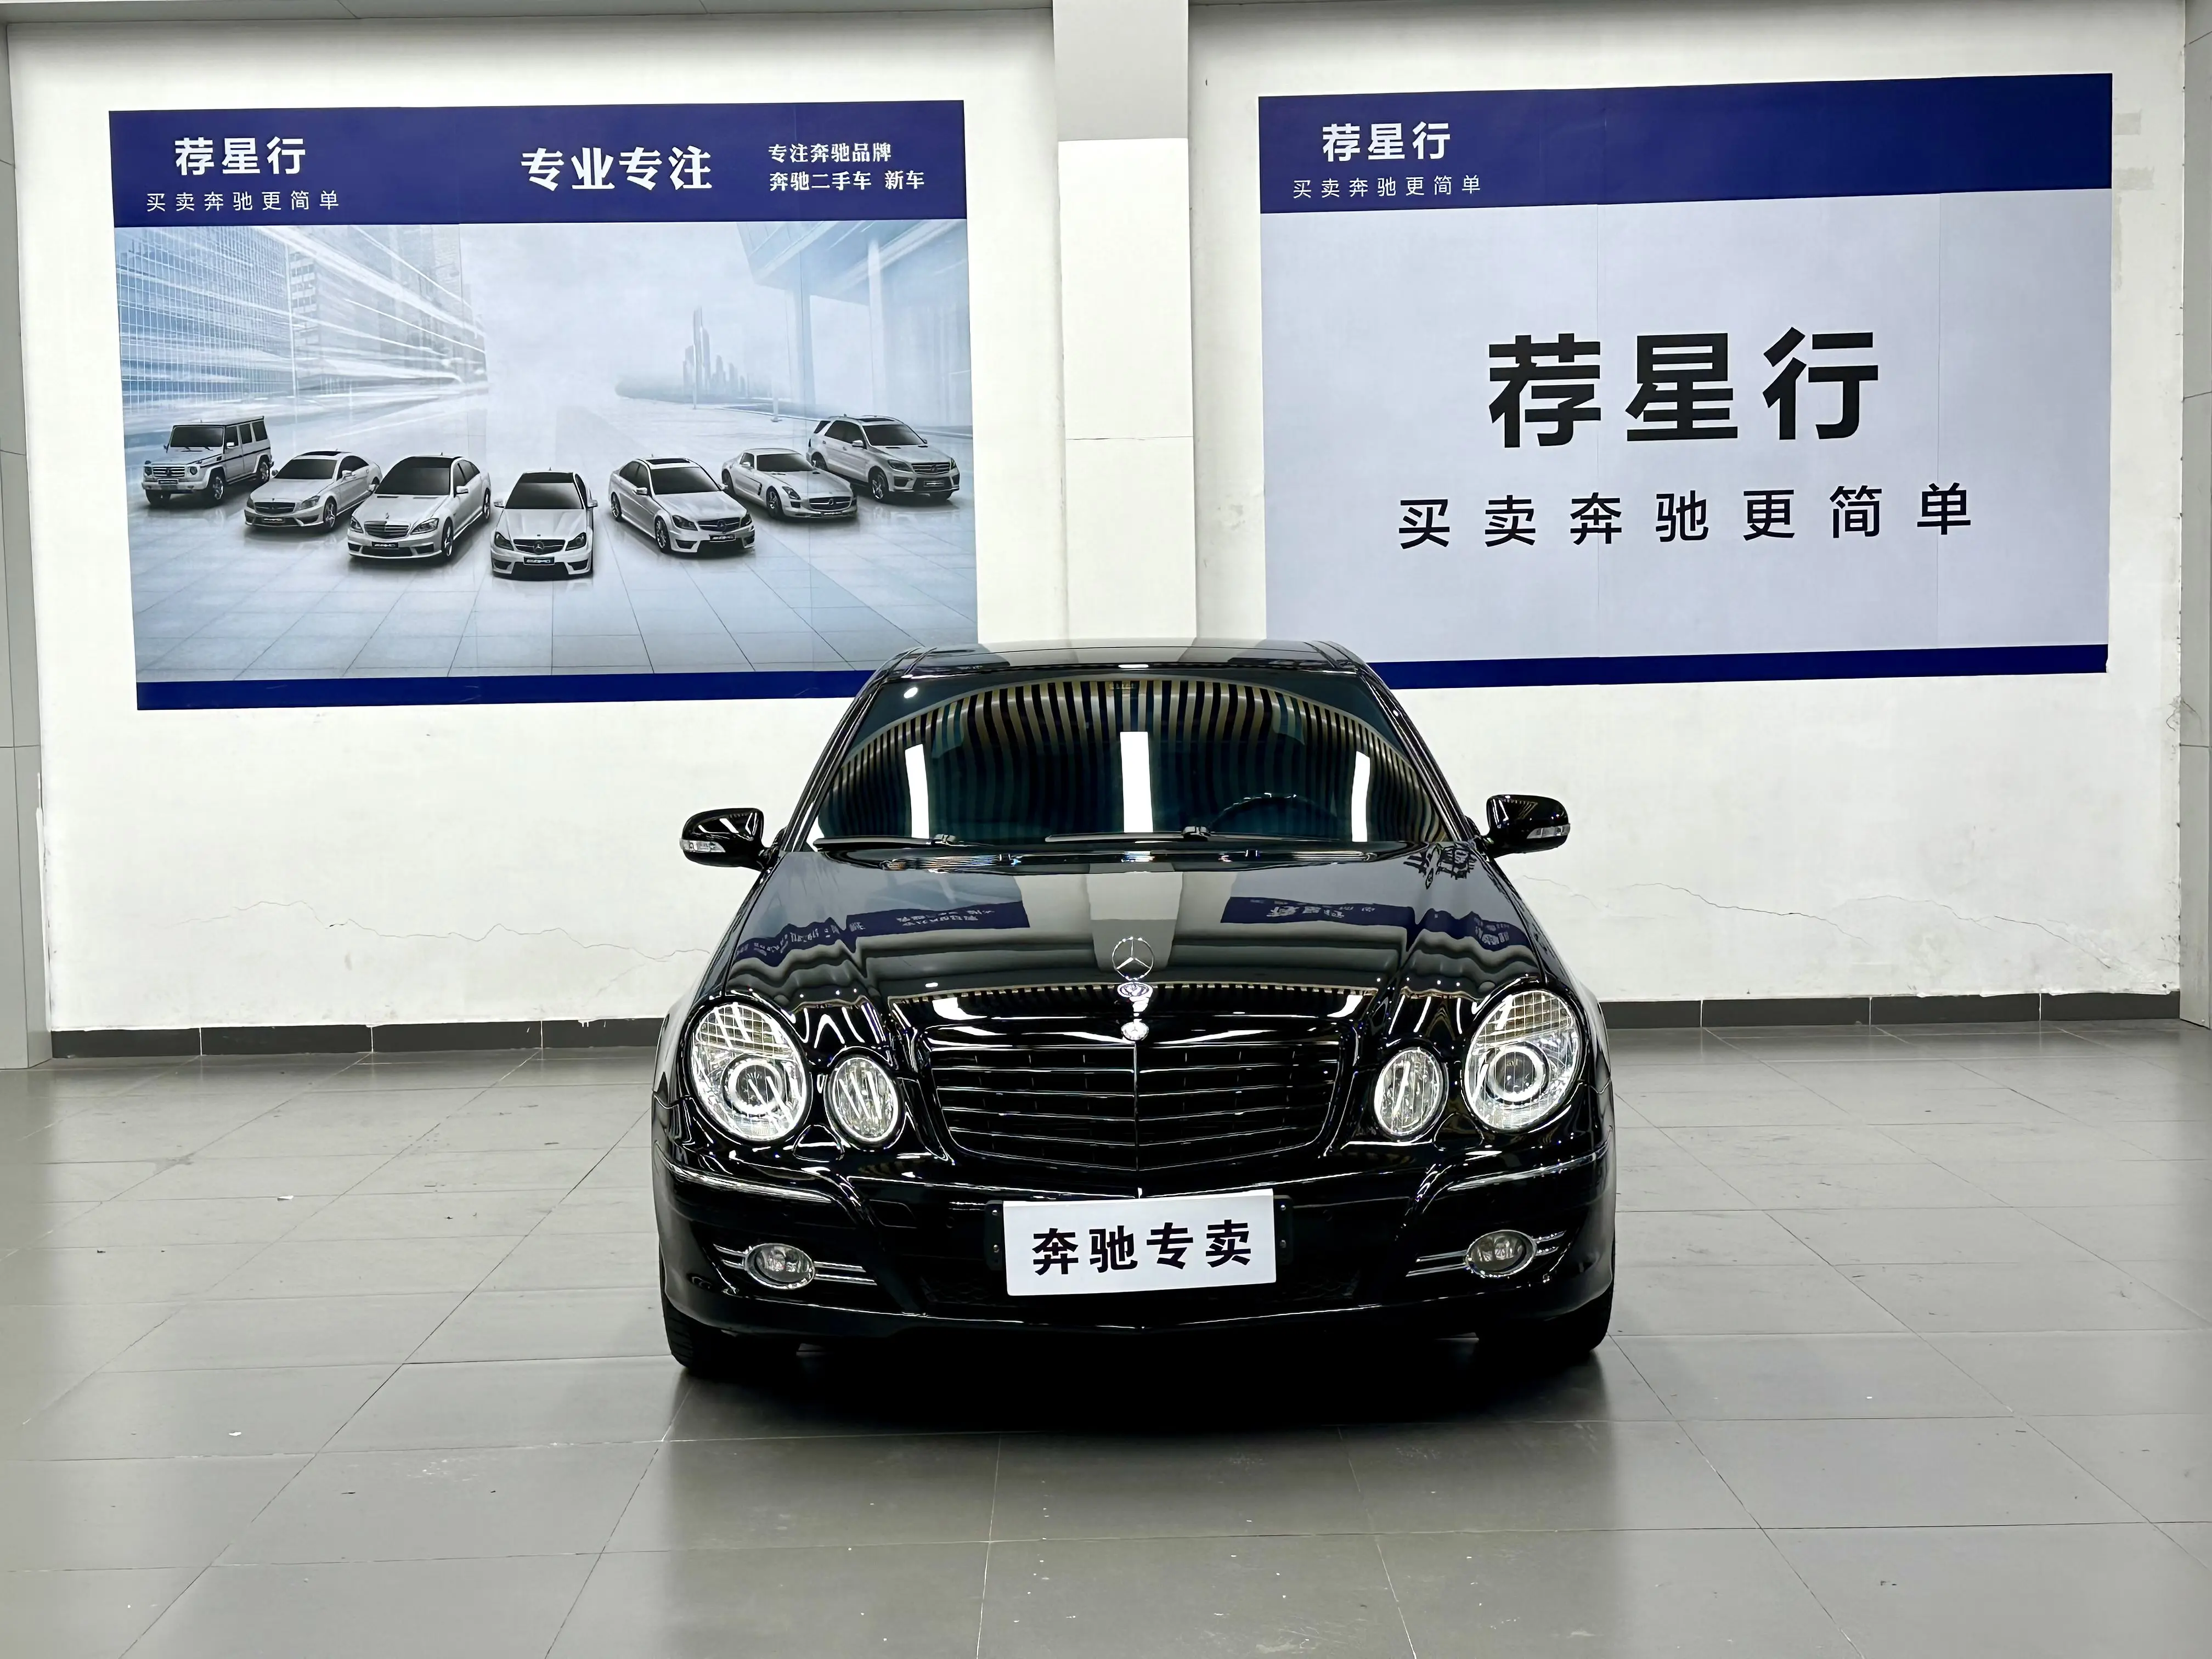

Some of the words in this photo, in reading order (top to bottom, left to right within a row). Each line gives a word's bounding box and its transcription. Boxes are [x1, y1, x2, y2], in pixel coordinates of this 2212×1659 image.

[174, 136, 306, 176] 荐星行
[768, 142, 891, 163] 专注奔驰品牌
[1323, 121, 1451, 162] 荐星行
[521, 145, 713, 191] 专业专注
[770, 171, 872, 191] 奔驰二手车
[884, 170, 924, 190] 新车
[1293, 174, 1481, 199] 买卖奔驰更简单
[146, 190, 339, 212] 买卖奔驰更简单
[1488, 326, 1878, 448] 荐星行
[1398, 482, 1971, 550] 买卖奔驰更简单
[1031, 1219, 1251, 1276] 奔驰专卖
